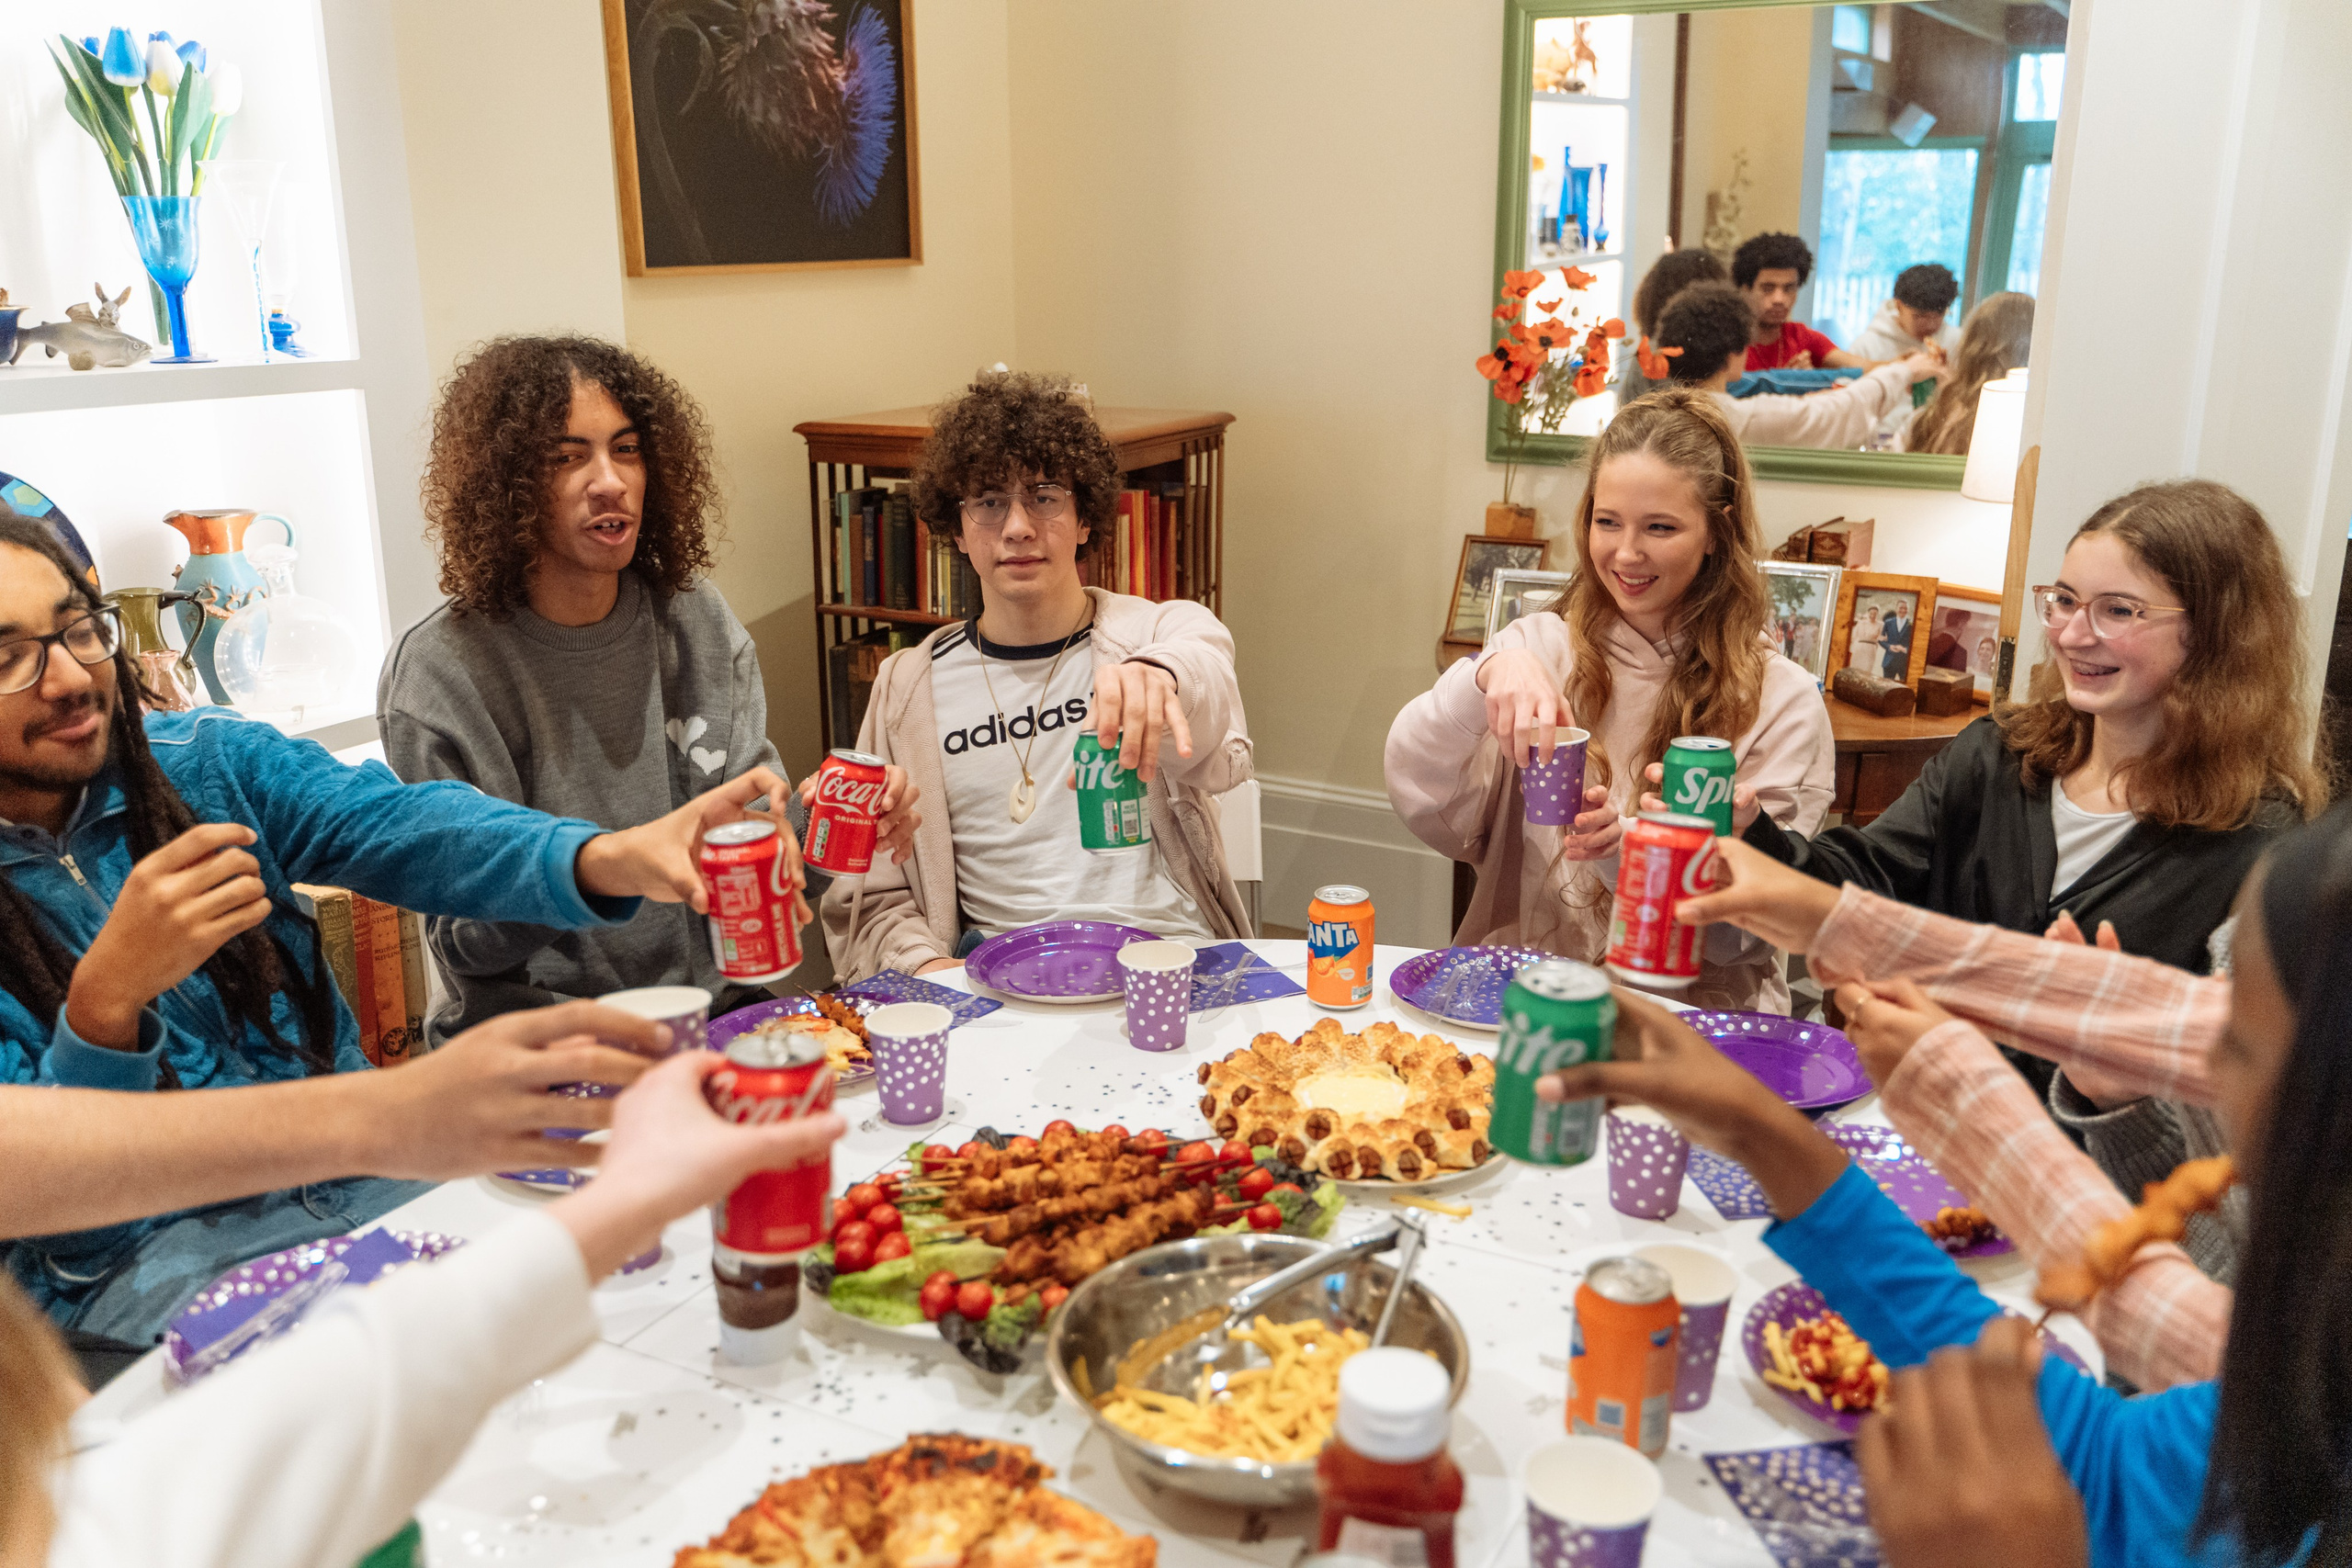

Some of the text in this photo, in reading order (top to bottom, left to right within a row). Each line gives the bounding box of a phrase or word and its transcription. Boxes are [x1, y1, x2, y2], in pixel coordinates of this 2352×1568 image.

[944, 698, 1088, 755] adidas
[1074, 750, 1125, 790] ite
[816, 766, 888, 817] Coca-C
[834, 814, 872, 826] ORIGINAL
[1307, 921, 1359, 948] ANTA
